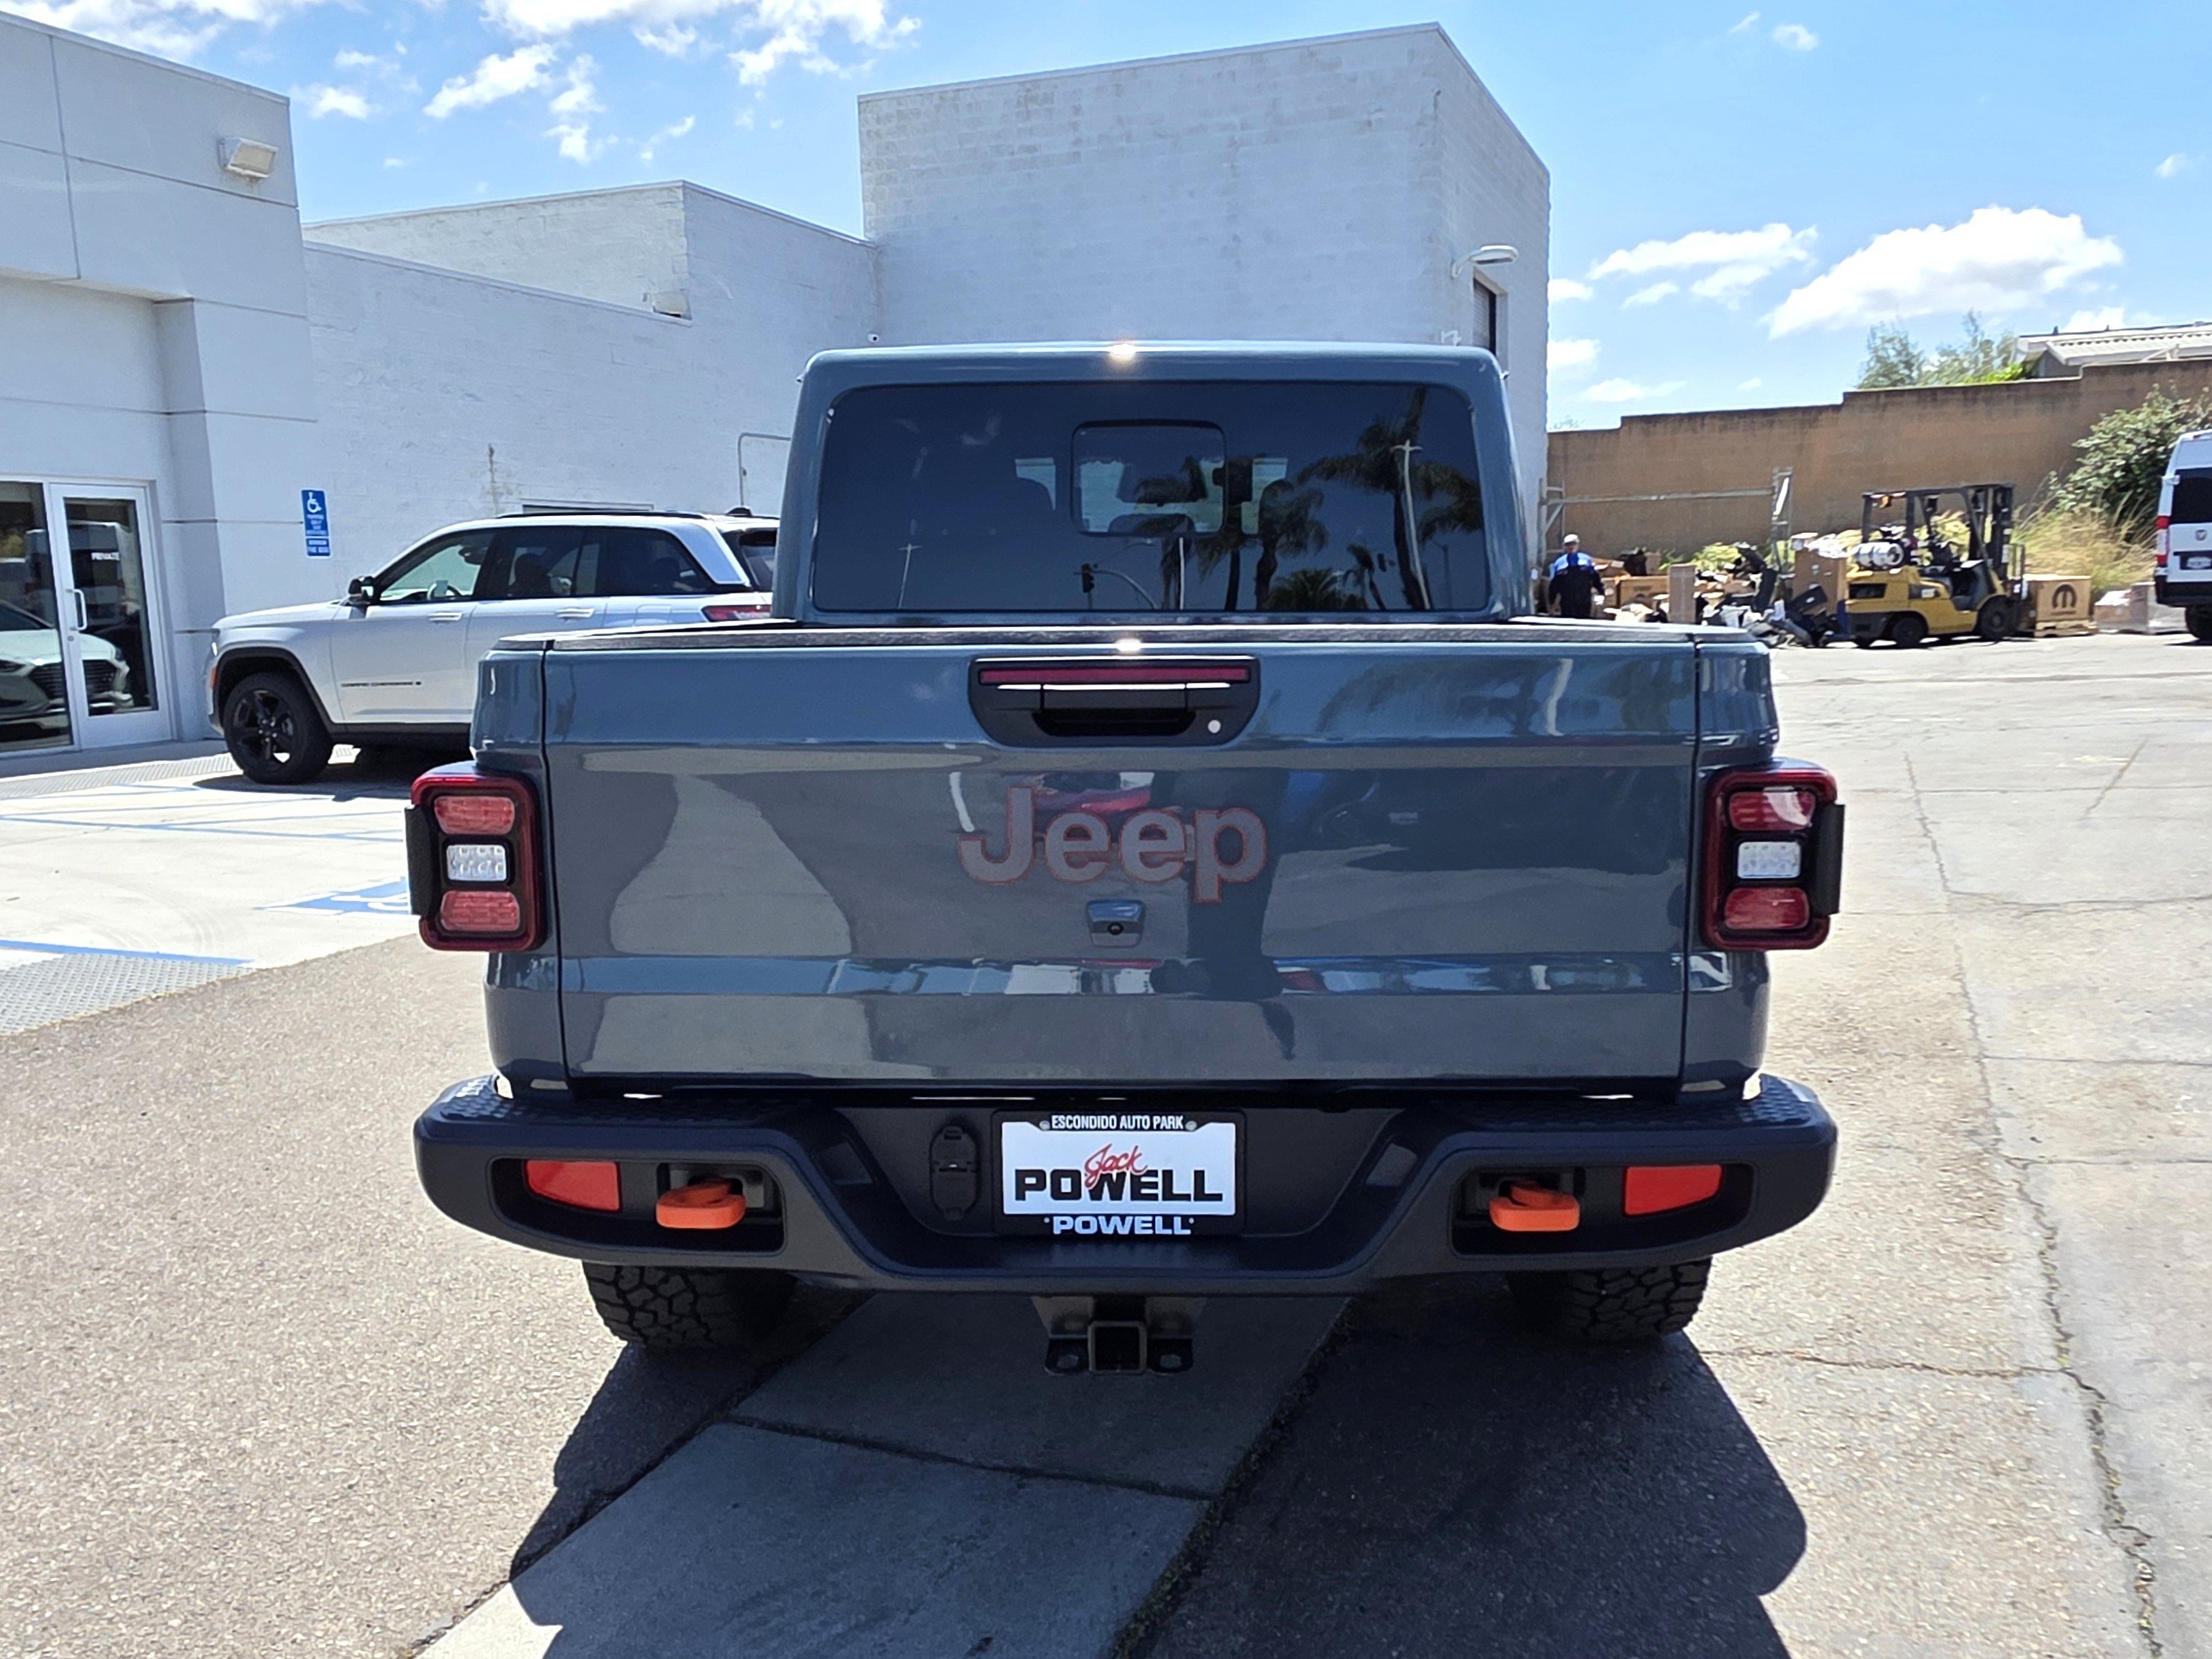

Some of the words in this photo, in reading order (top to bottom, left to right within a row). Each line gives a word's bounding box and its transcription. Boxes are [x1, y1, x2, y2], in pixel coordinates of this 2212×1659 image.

[958, 785, 1269, 904] Jeep
[1051, 1115, 1117, 1130] ESCONDIDO
[1120, 1115, 1150, 1130] AUTO
[1152, 1115, 1184, 1130] PARK
[1084, 1143, 1148, 1188] Jack
[1014, 1169, 1223, 1202] POWELL
[1053, 1215, 1192, 1235] POWELL
